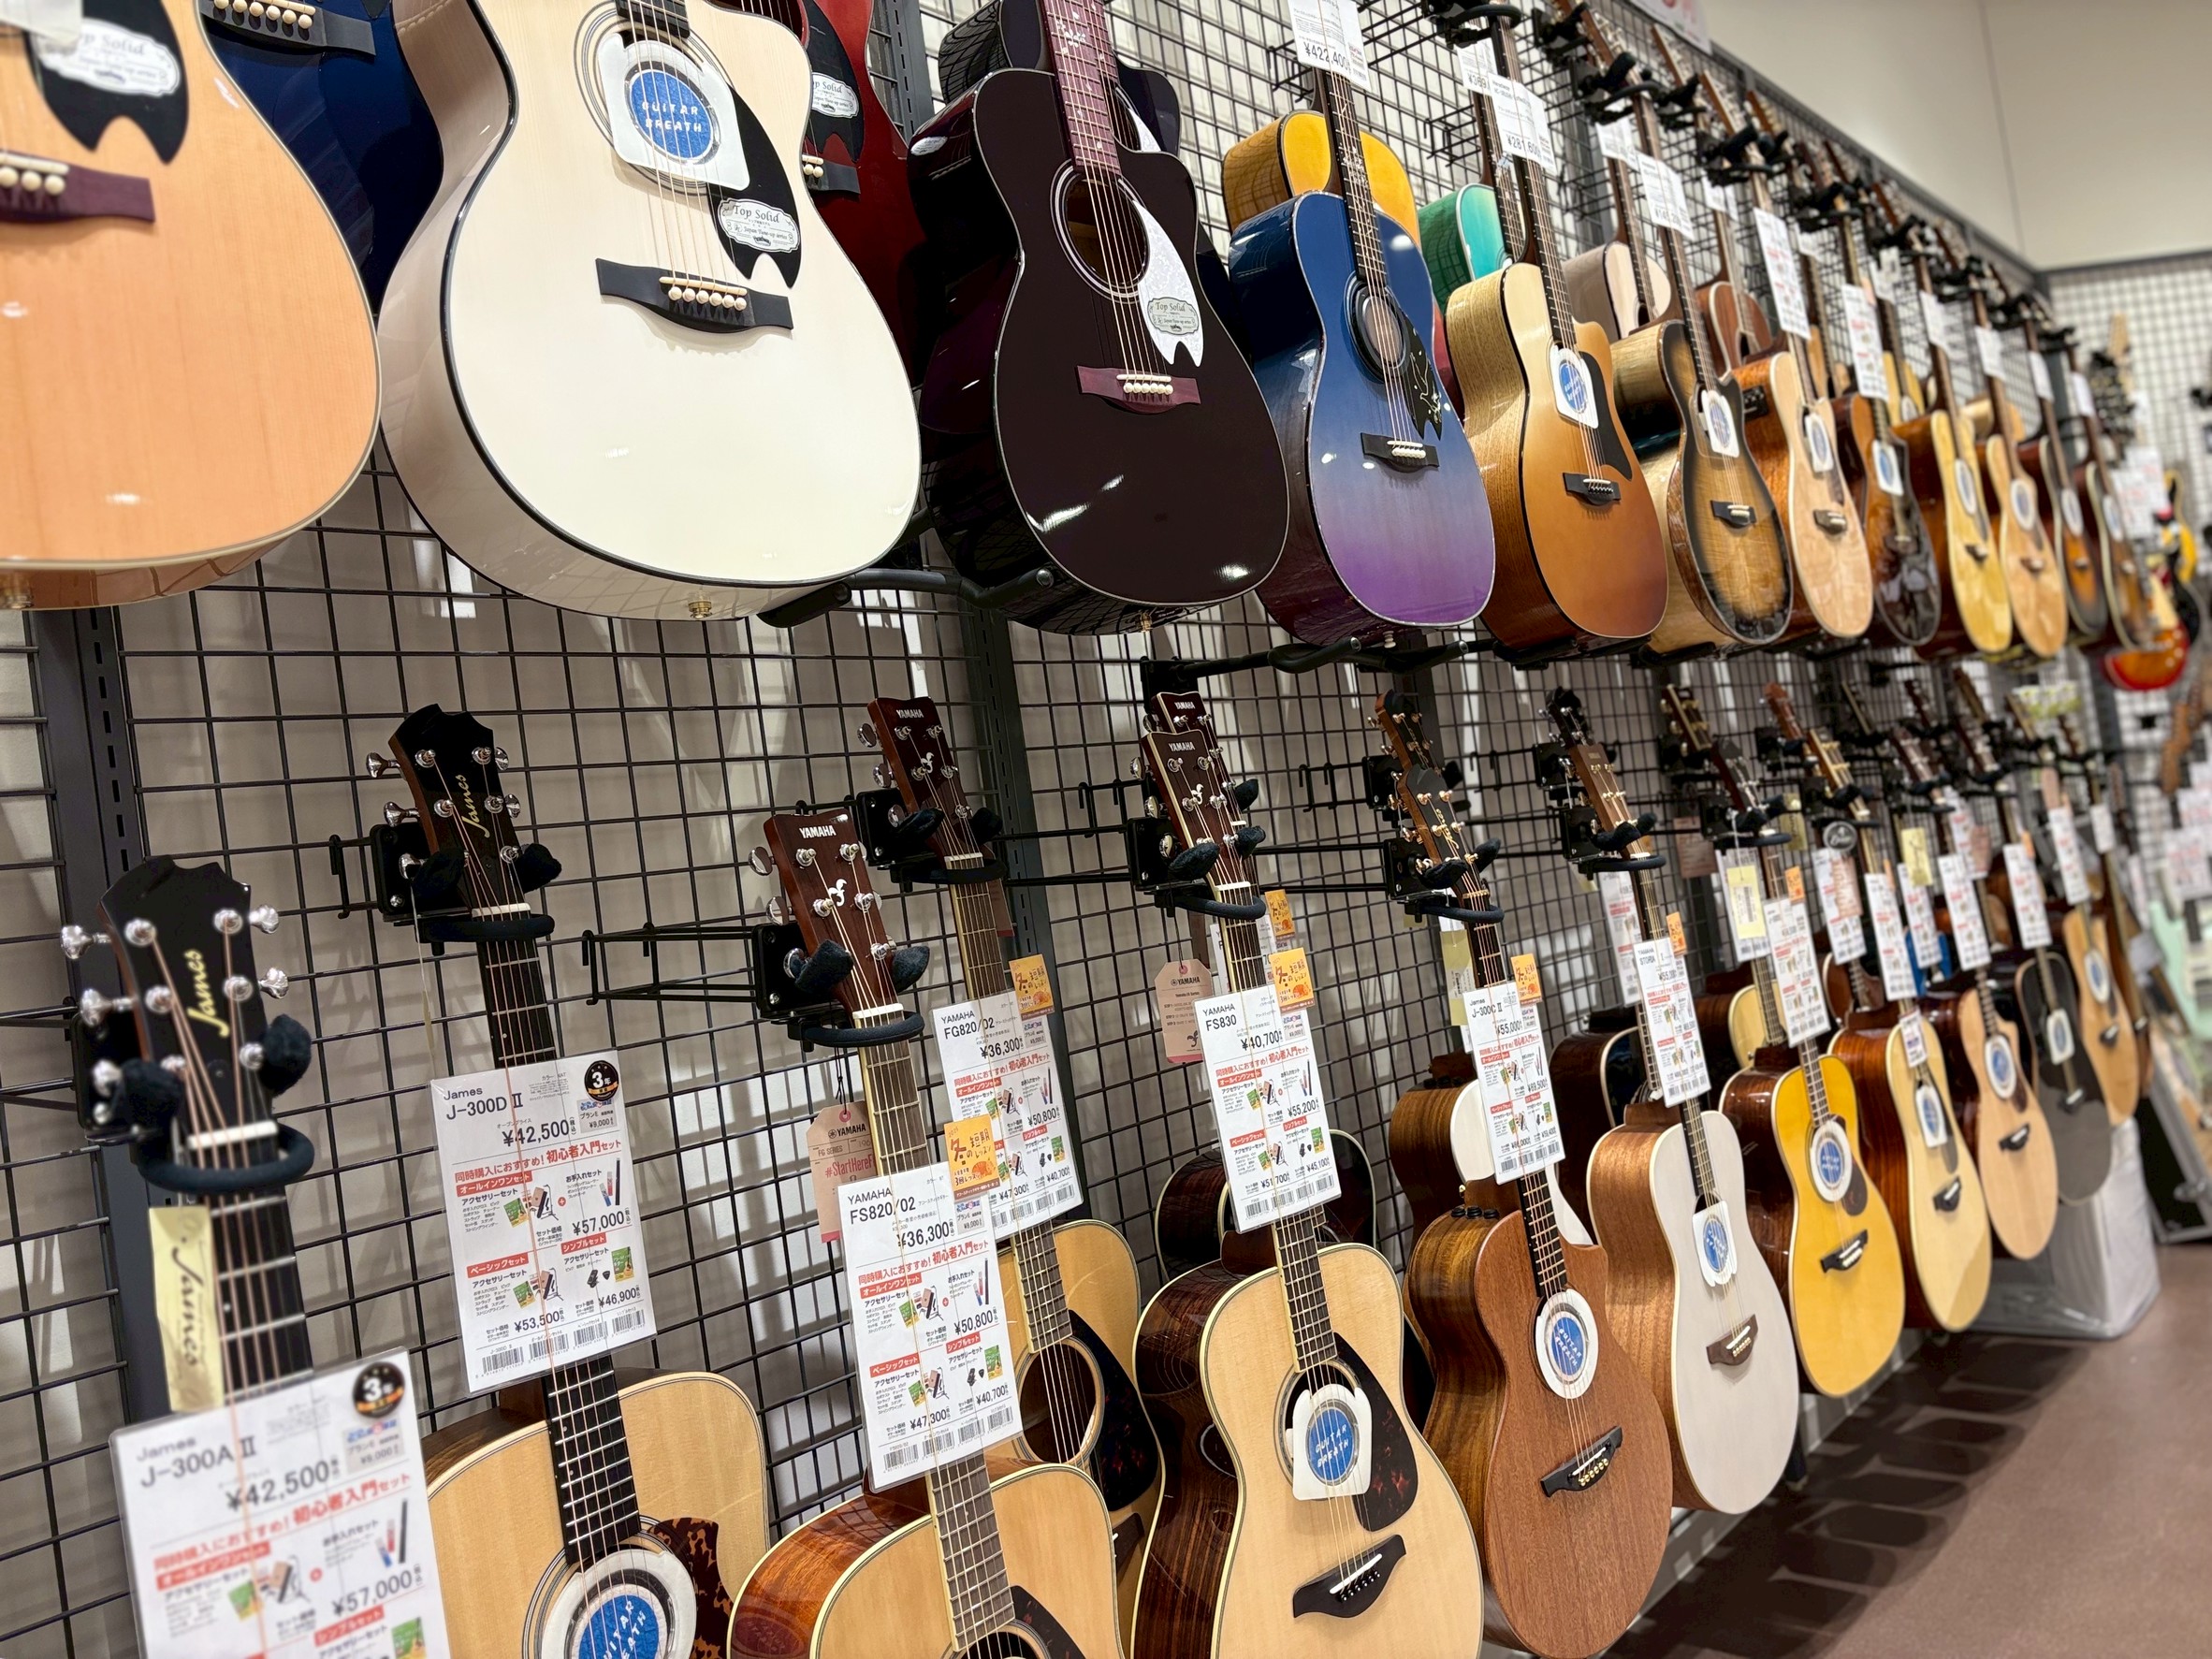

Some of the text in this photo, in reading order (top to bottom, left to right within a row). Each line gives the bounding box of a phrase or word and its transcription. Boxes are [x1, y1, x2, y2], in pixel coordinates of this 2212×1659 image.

[822, 81, 842, 94] Solid
[641, 101, 699, 116] GUITAR
[645, 119, 703, 133] BREATH
[733, 205, 780, 224] Top Solid
[1155, 302, 1186, 313] Top Solid
[896, 709, 924, 719] YAMAHA
[1169, 741, 1196, 751] YAMAHA
[799, 825, 837, 838] YAMAHA
[1177, 976, 1201, 985] YAMAHA
[1202, 1003, 1236, 1017] YAMAHA
[1469, 998, 1486, 1007] James
[941, 1010, 975, 1025] YAMAHA
[1205, 1014, 1237, 1031] FS830
[944, 1017, 995, 1040] FG820/02
[980, 1037, 1020, 1059] ¥36,300
[1240, 1030, 1279, 1051] ¥40,700
[591, 1071, 611, 1088] 3年
[444, 1086, 483, 1101] James
[446, 1098, 507, 1120] J-300D
[1027, 1108, 1057, 1127] ¥50,800
[1288, 1099, 1317, 1118] ¥55,200
[589, 1118, 610, 1128] ¥9,000
[837, 1123, 866, 1137] YAMAHA
[502, 1119, 570, 1147] ¥42,500
[969, 1128, 991, 1148] 短期
[818, 1145, 843, 1157] FG SERIES
[1306, 1158, 1328, 1173] ¥45,100
[459, 1172, 531, 1194] オールインワンセット
[565, 1169, 602, 1183] お手入れセット
[1046, 1168, 1068, 1184] ¥40,700
[461, 1188, 518, 1206] アクセサリーセット
[847, 1186, 894, 1205] YAMAHA
[850, 1196, 916, 1225] FS820/02
[536, 1226, 562, 1237] セット価格
[572, 1211, 624, 1236] ¥57,000
[896, 1221, 950, 1248] ¥36,300
[563, 1235, 605, 1253] シンプルセット
[564, 1247, 609, 1264] アクセサリーセット
[470, 1257, 526, 1274] ベーシックセット
[473, 1270, 527, 1288] アクセサリーセット
[863, 1276, 920, 1297] オールインワンセット
[599, 1288, 636, 1308] ¥46,900
[865, 1289, 910, 1308] アクセサリーセット
[514, 1311, 560, 1332] ¥53,500
[954, 1309, 994, 1335] ¥50,800
[947, 1335, 980, 1351] シンプルセット
[1554, 1335, 1579, 1366] BREATH
[1559, 1328, 1582, 1359] GUITAR
[948, 1346, 983, 1363] アクセサリーセット
[872, 1356, 919, 1375] ベーシックセット
[874, 1369, 920, 1388] アクセサリーセット
[976, 1385, 1006, 1405] ¥40,700
[135, 1435, 196, 1463] James
[140, 1447, 236, 1488] J-300A
[226, 1460, 330, 1511] ¥42,500
[331, 1569, 413, 1617] ¥57,000
